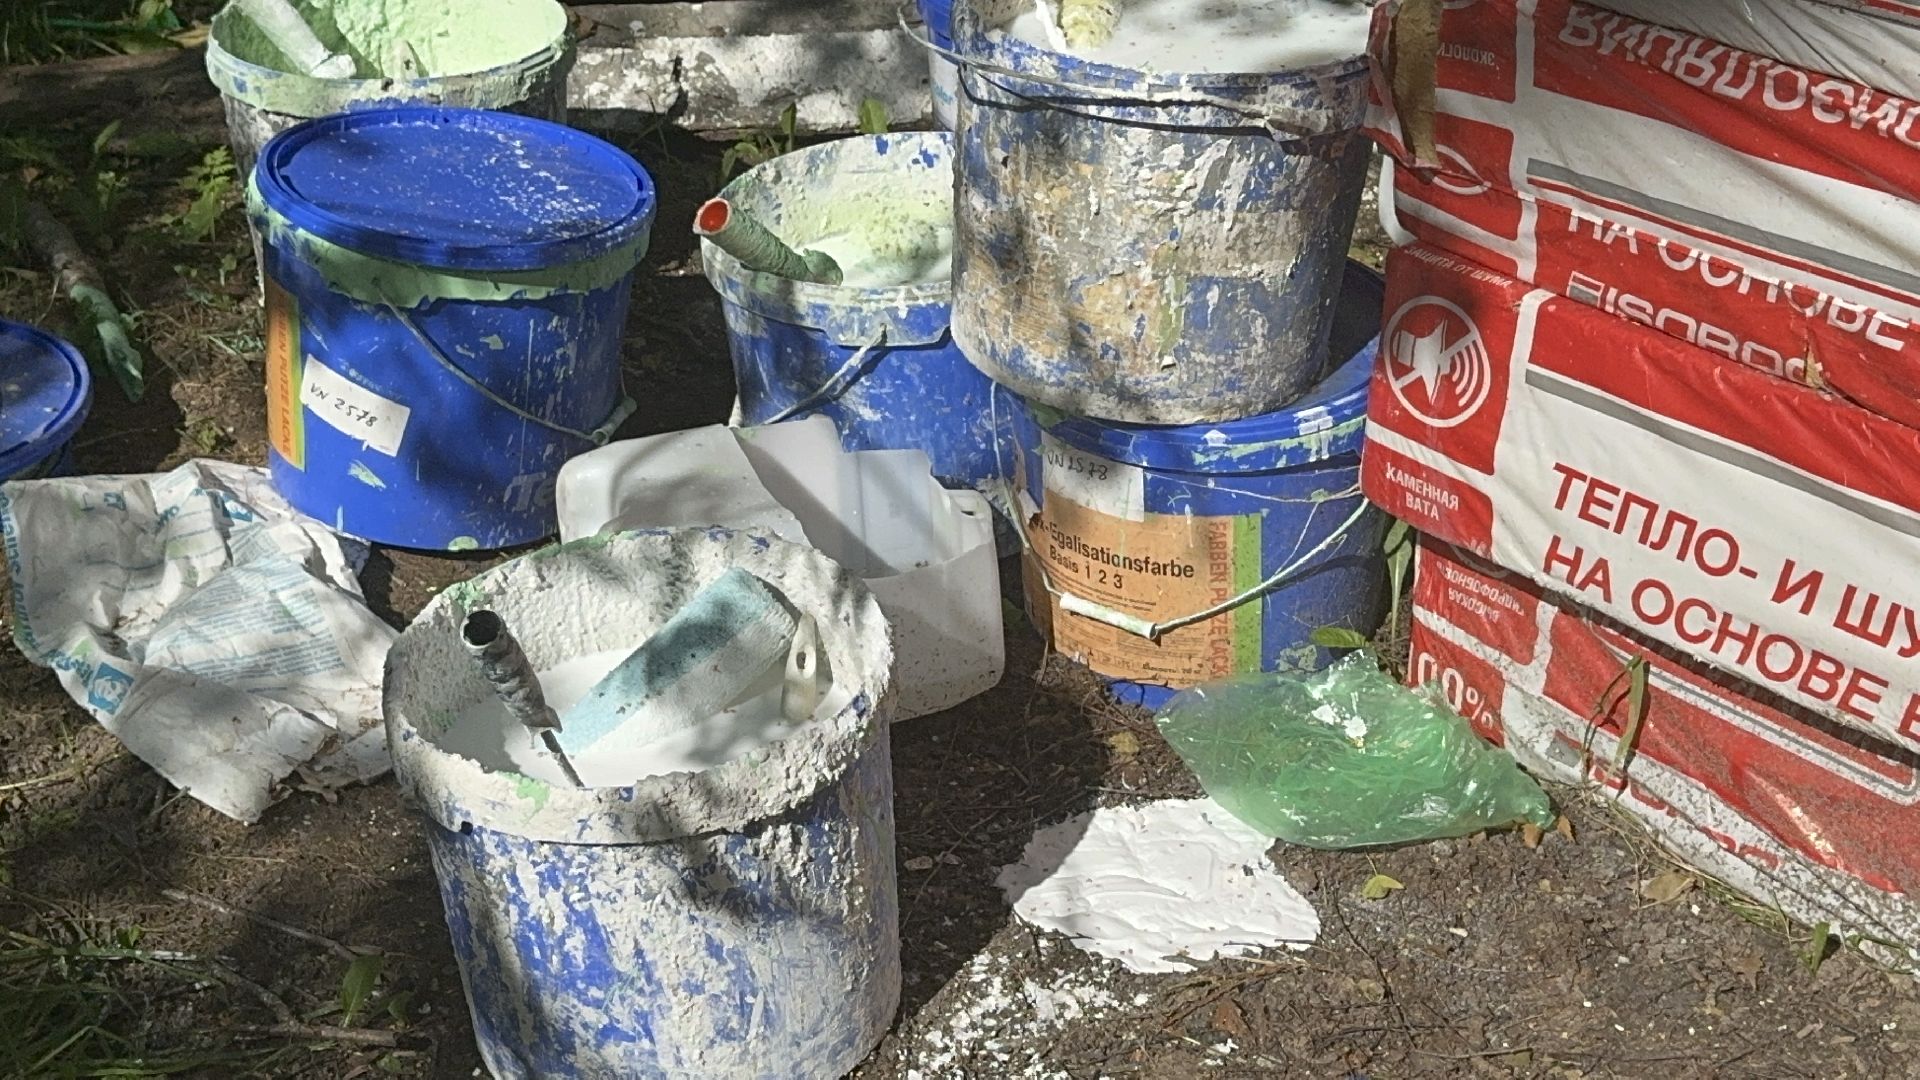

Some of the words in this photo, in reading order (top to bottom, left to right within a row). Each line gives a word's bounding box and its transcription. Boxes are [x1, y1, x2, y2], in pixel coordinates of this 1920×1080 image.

[1454, 264, 1474, 274] ОТ
[310, 382, 329, 400] VN
[334, 397, 379, 427] 2578
[1385, 461, 1459, 512] КАМЕННАЯ
[1405, 492, 1440, 521] ВАТА
[1209, 521, 1229, 583] FARBEN
[1553, 462, 1758, 579] ТЕПЛО-
[1770, 558, 1824, 616] И
[1050, 545, 1079, 574] Basis
[1085, 564, 1091, 579] 1
[1098, 569, 1107, 585] 2
[1113, 574, 1123, 589] 3
[1543, 535, 1612, 604] НА
[1631, 578, 1889, 723] ОСНОВЕ
